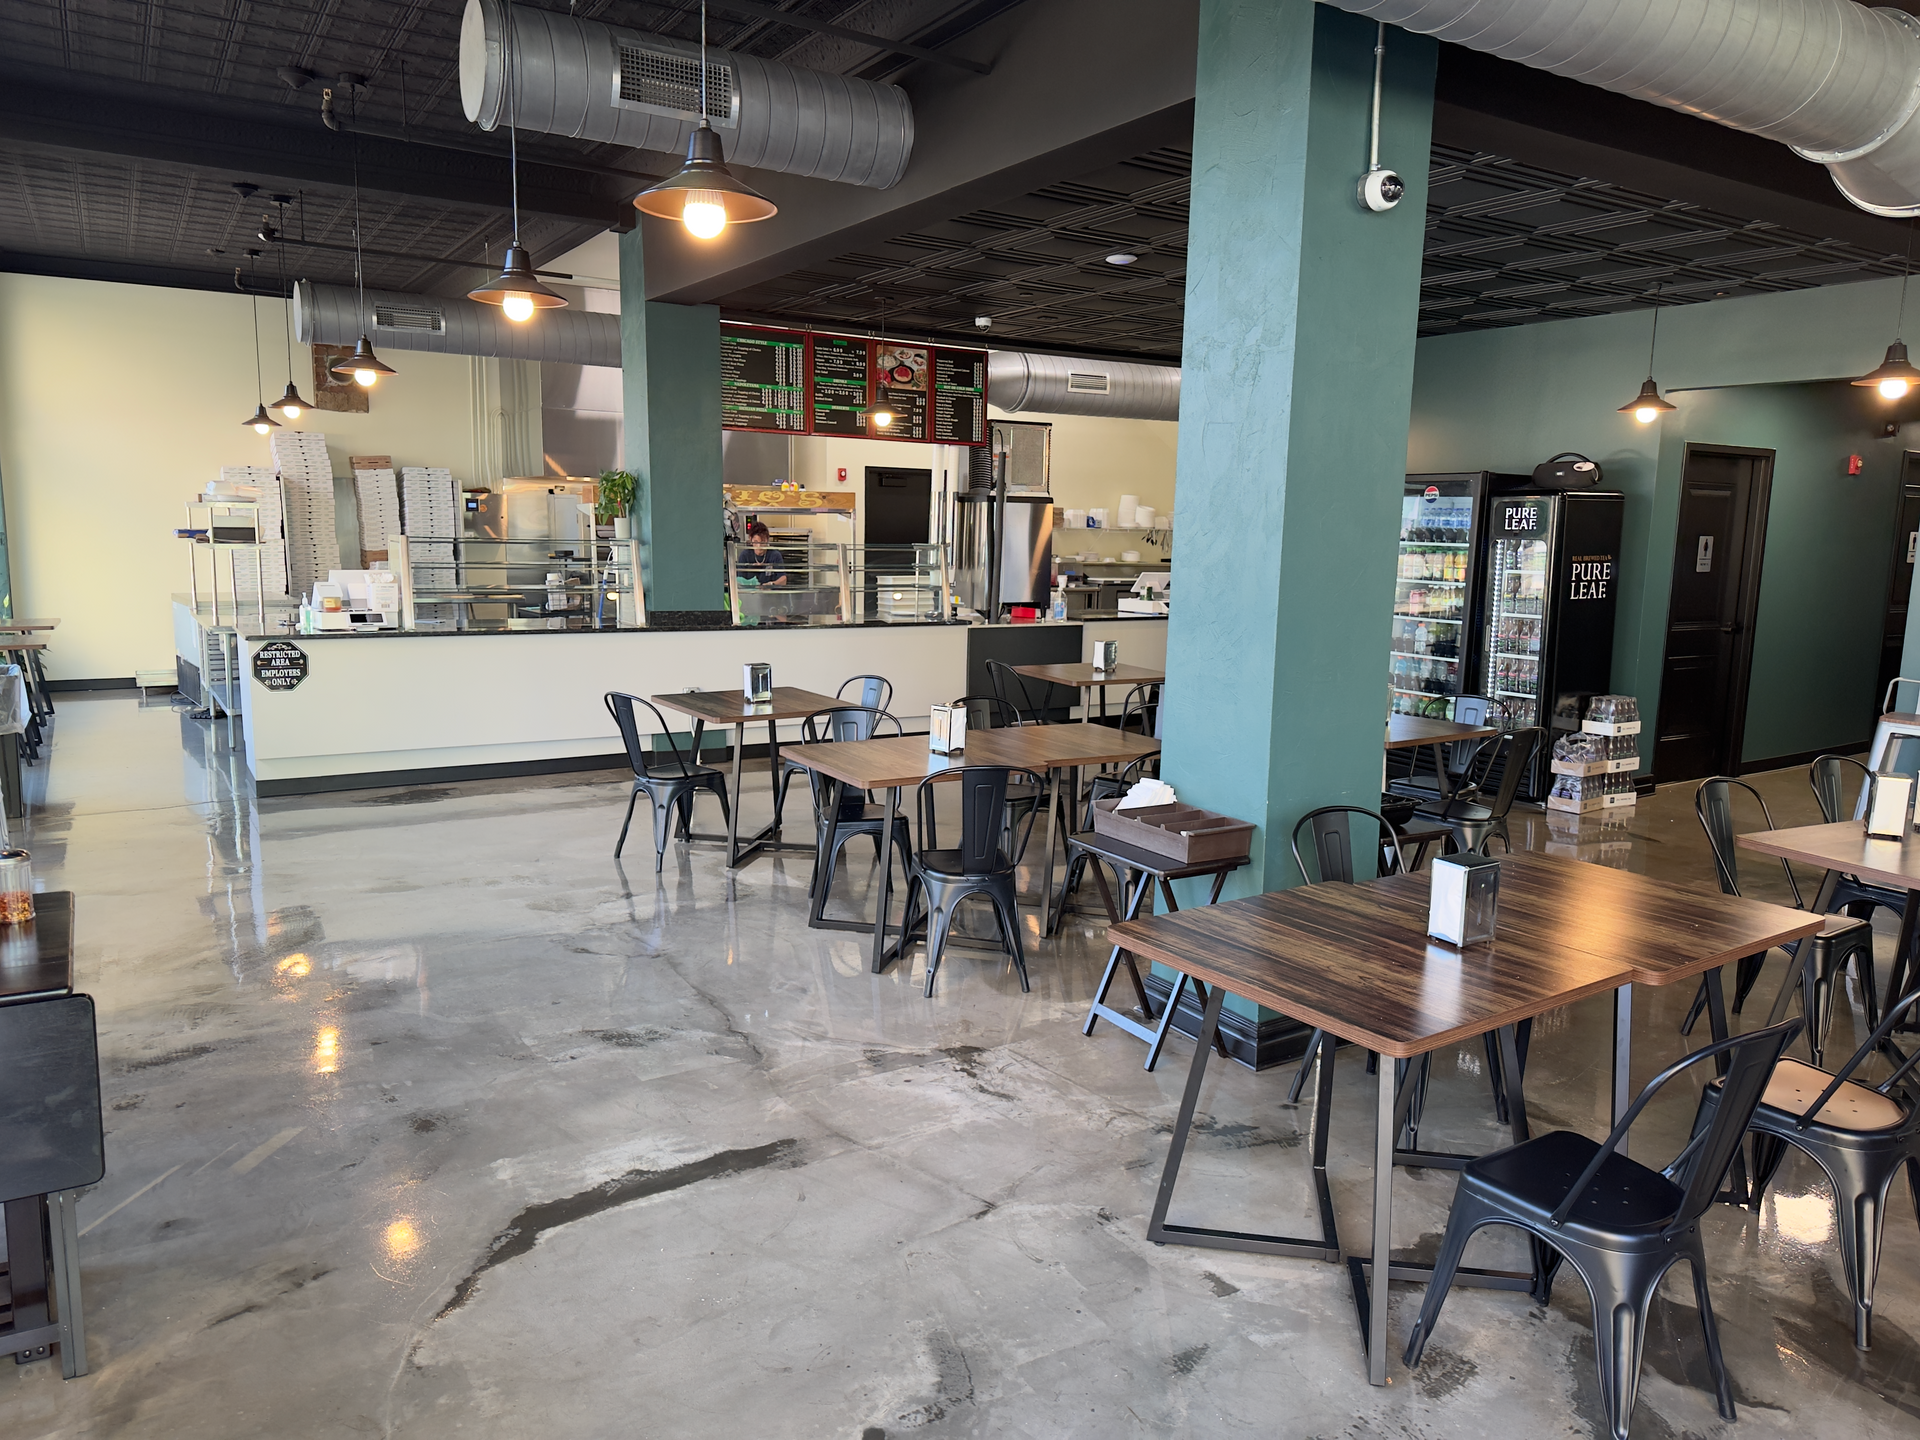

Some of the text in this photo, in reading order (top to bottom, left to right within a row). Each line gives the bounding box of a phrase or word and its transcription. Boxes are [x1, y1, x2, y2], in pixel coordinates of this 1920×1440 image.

[723, 489, 823, 508] IO'S
[1505, 507, 1537, 518] PURE
[1571, 562, 1611, 580] PURE
[259, 650, 301, 658] RESTRICTED
[270, 658, 290, 666] AREA
[261, 669, 301, 677] EMPLOYEES
[271, 678, 291, 686] ONLY
